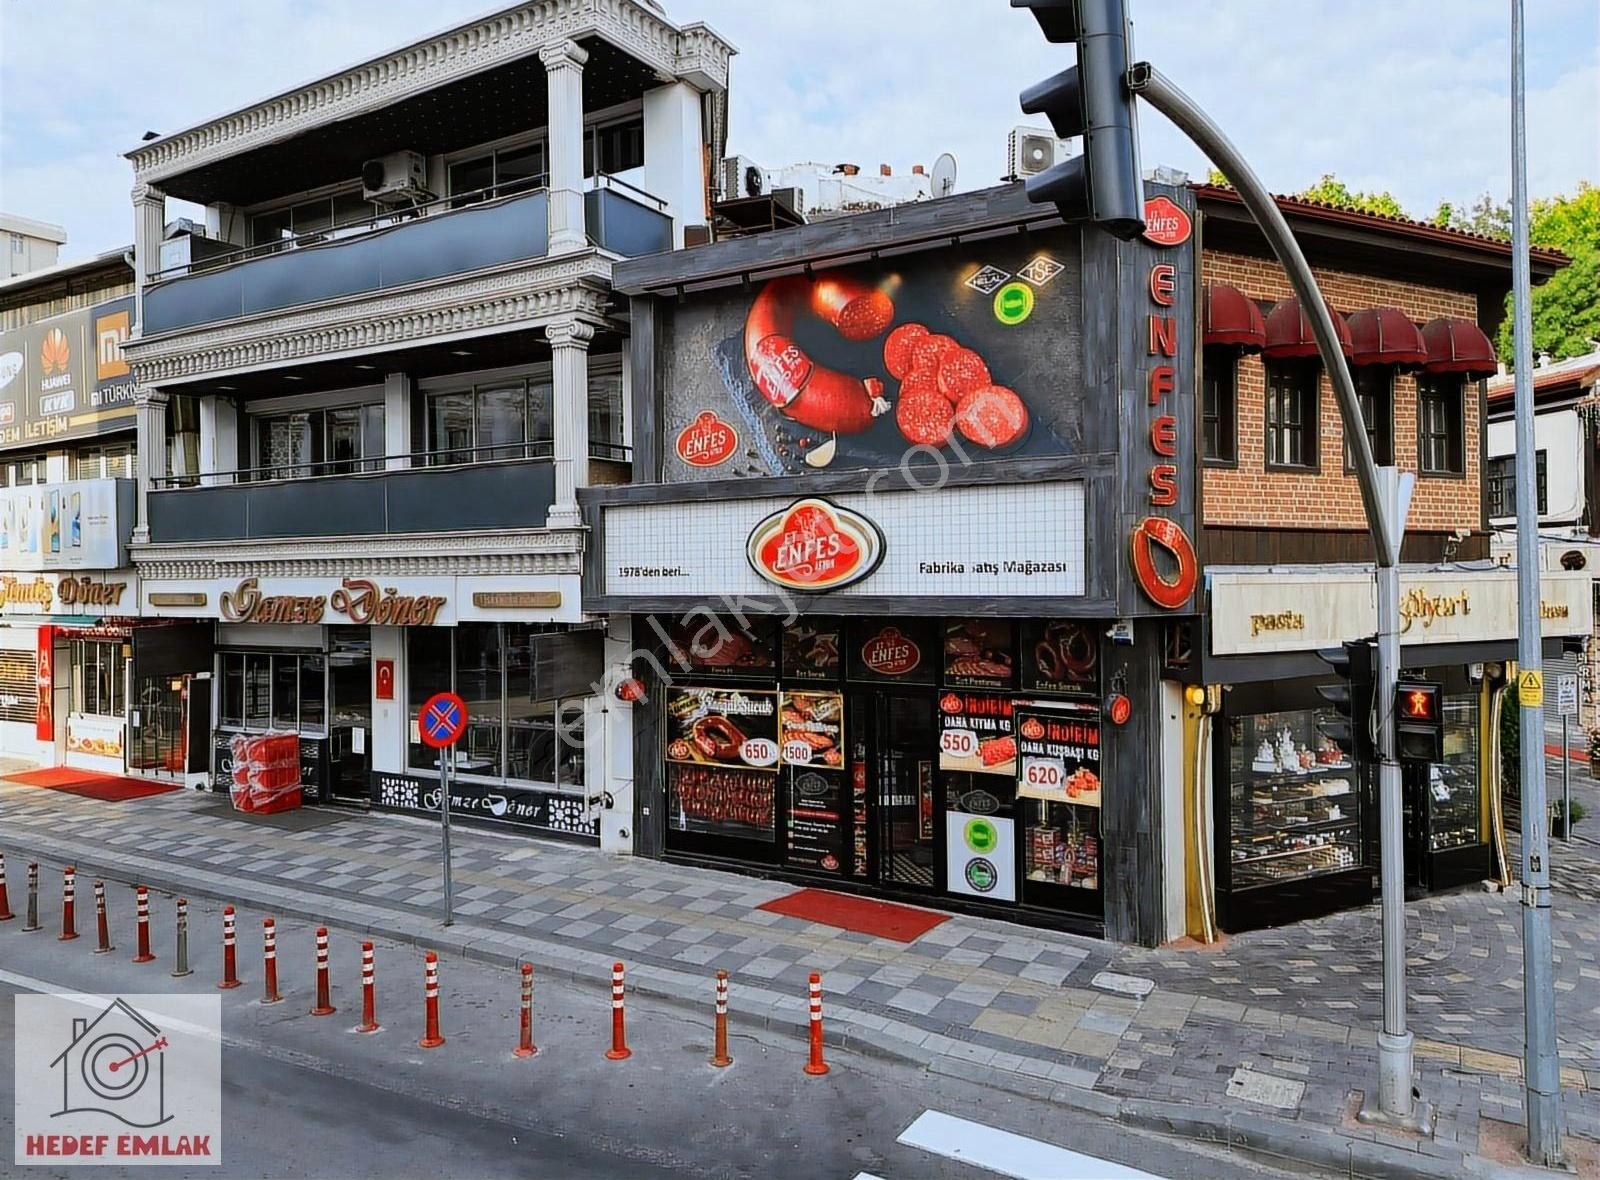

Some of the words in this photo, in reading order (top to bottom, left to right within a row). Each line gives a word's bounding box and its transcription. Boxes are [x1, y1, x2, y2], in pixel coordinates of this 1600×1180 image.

[1147, 216, 1178, 232] ENFES
[1028, 261, 1053, 281] TSE
[1149, 264, 1177, 506] ENFES
[686, 430, 726, 456] ENFES
[777, 533, 840, 569] ENFES
[618, 566, 660, 578] 1978'den
[919, 561, 965, 574] Fabrika
[1003, 560, 1067, 577] Mağazası
[58, 576, 127, 606] Döner
[219, 577, 327, 624] Gamze
[331, 577, 447, 626] Döner
[872, 645, 909, 663] ENFES
[1000, 719, 1011, 731] KG
[745, 743, 768, 758] 650
[944, 733, 970, 752] 550
[785, 746, 808, 760] 1500
[1087, 748, 1099, 761] KG
[1028, 766, 1058, 784] 620
